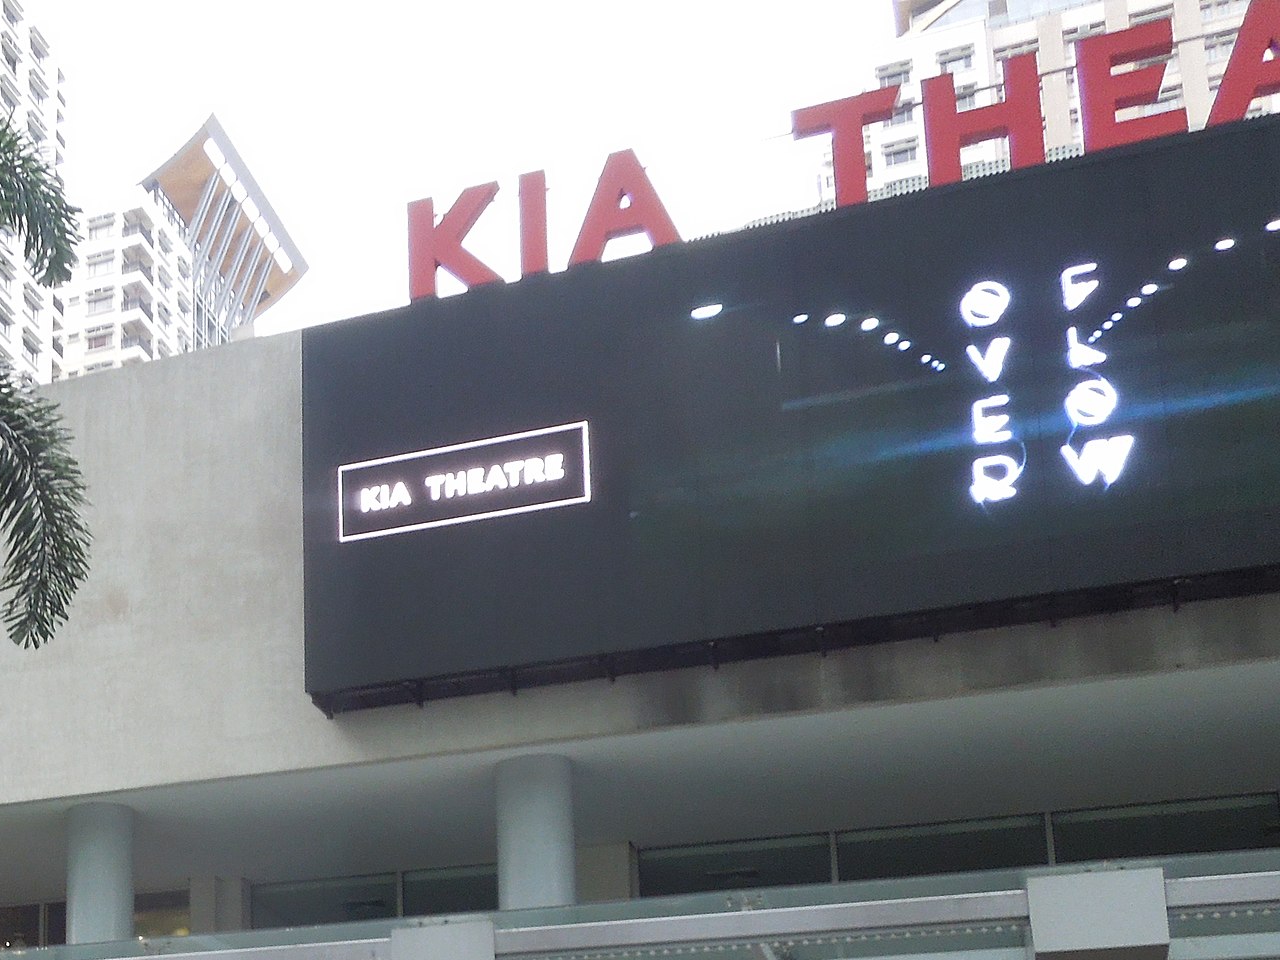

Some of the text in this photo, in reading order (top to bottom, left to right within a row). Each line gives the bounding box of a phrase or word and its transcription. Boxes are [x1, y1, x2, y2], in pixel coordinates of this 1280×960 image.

[407, 148, 684, 301] KIA
[360, 453, 565, 513] KIA THEATRE
